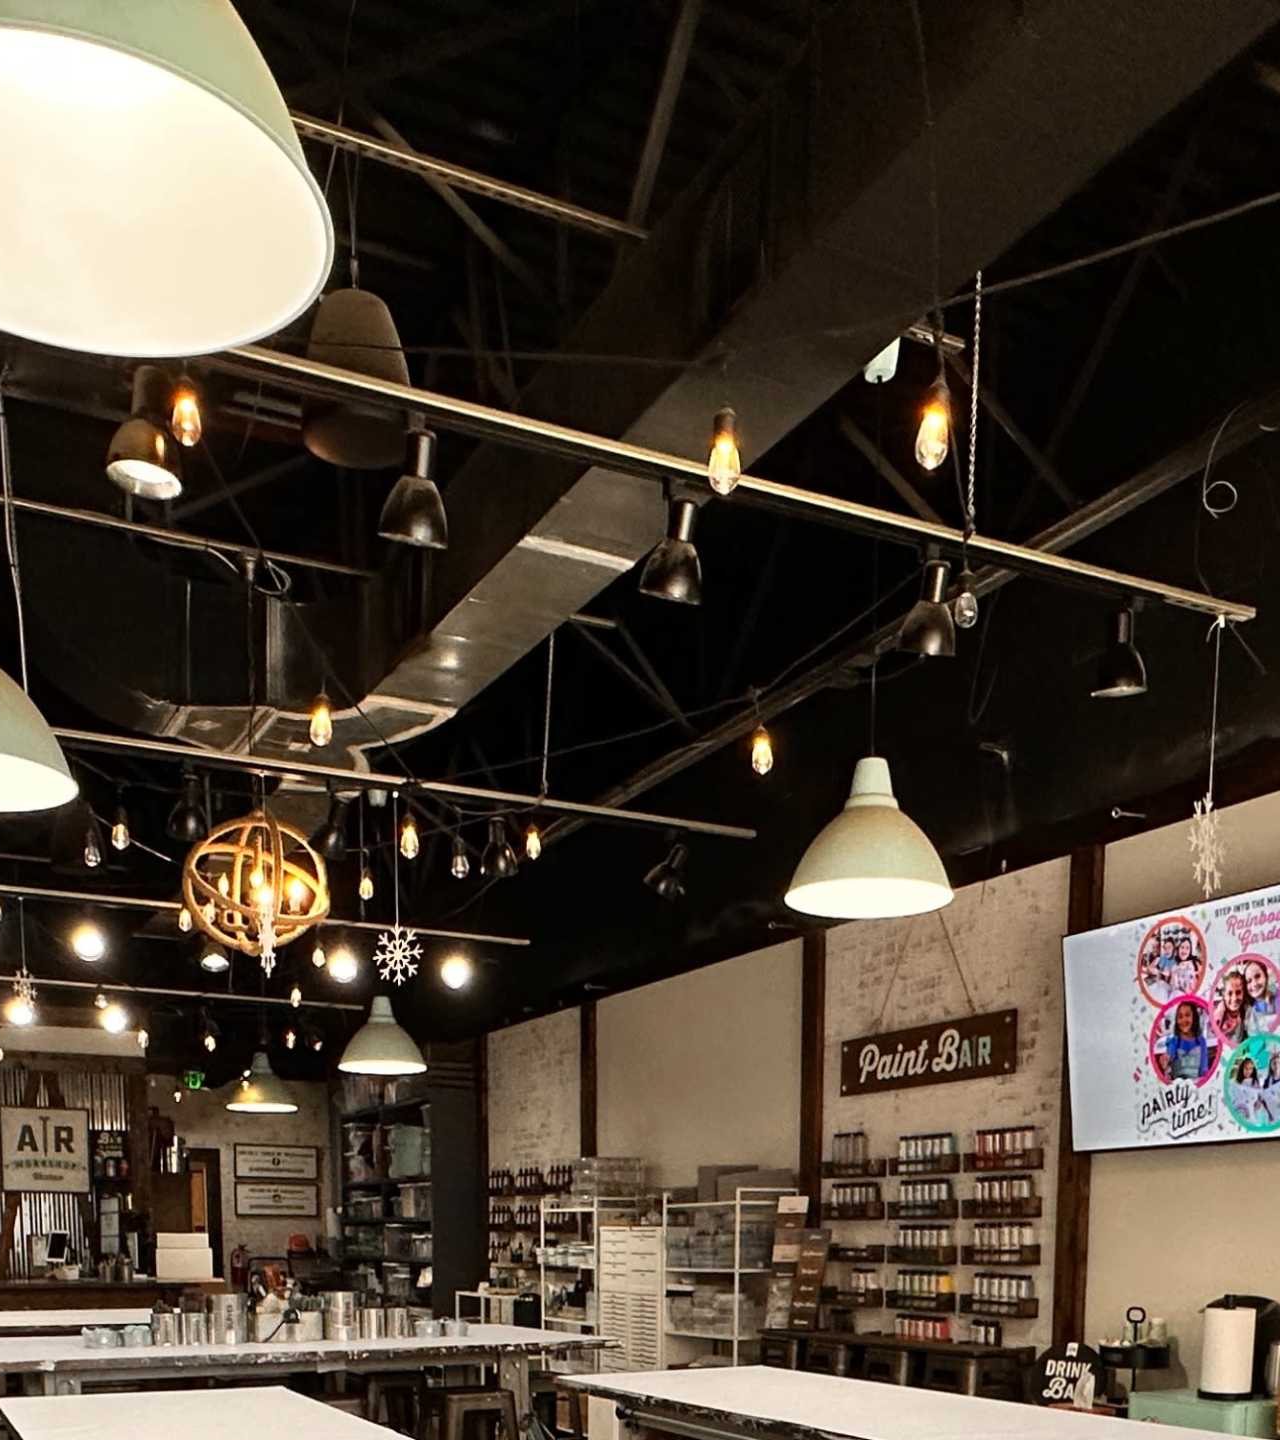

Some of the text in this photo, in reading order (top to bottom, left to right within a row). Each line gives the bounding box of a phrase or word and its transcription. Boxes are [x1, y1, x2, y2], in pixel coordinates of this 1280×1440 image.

[1214, 906, 1232, 918] STEP
[1233, 902, 1250, 912] INTO
[1251, 898, 1265, 909] THE
[859, 1039, 929, 1084] Paint
